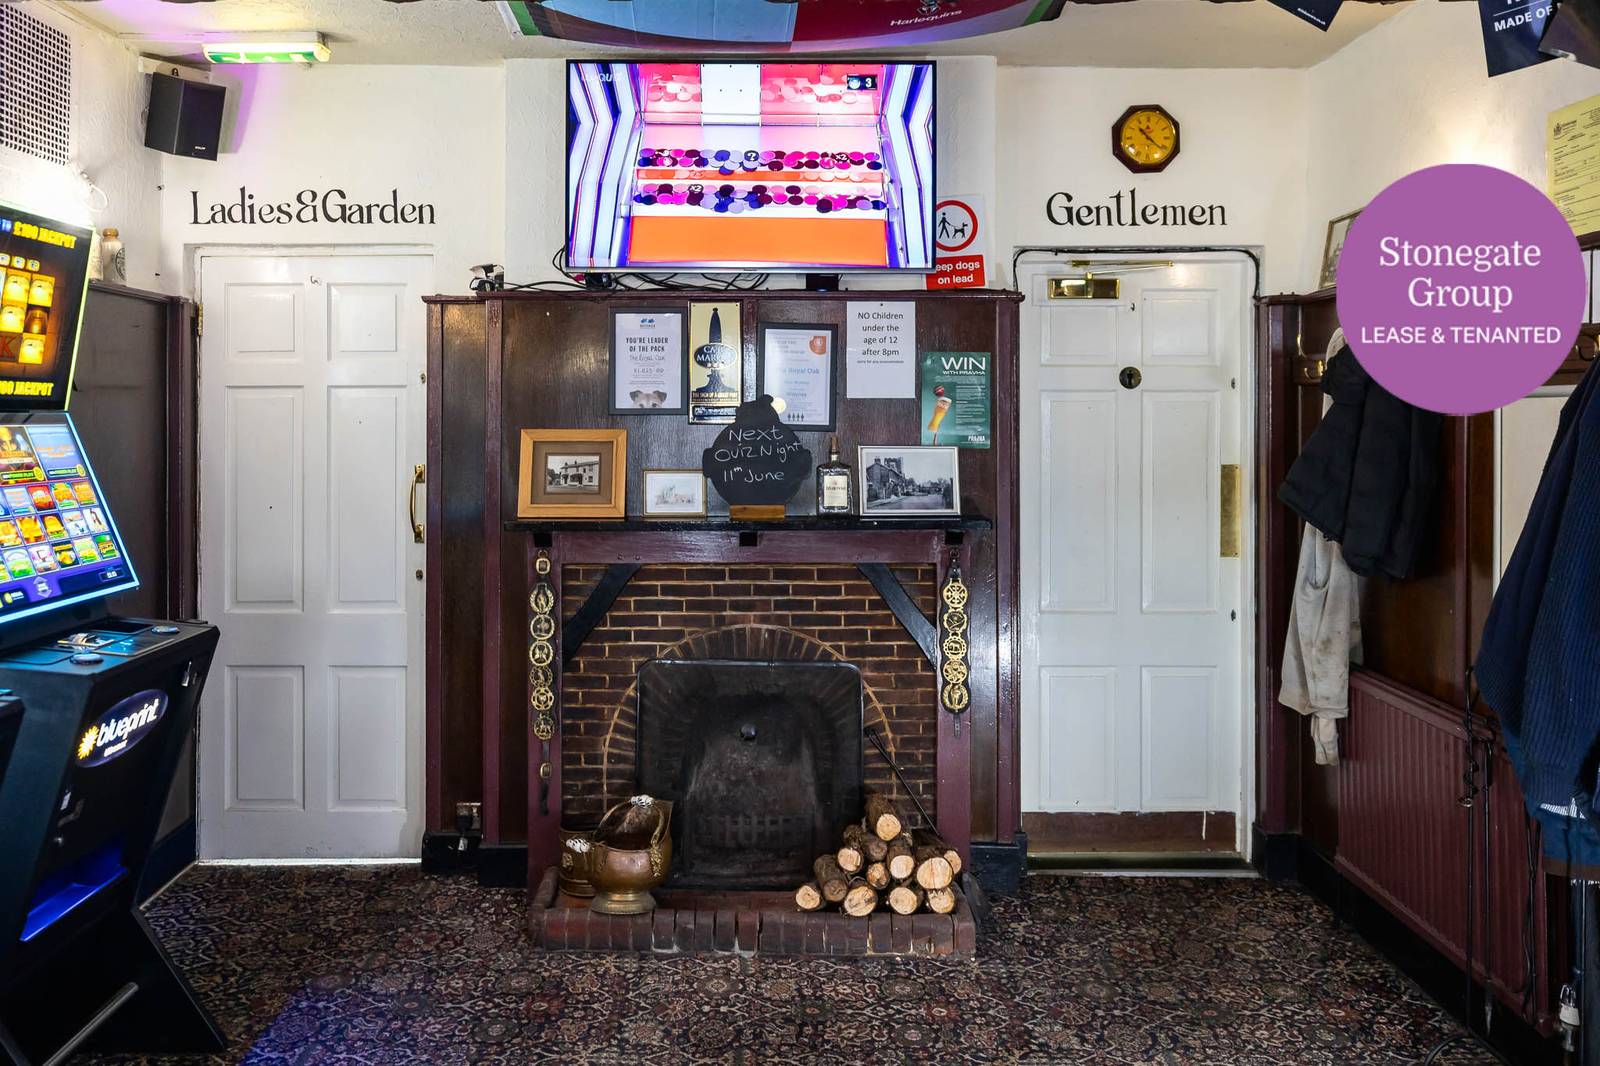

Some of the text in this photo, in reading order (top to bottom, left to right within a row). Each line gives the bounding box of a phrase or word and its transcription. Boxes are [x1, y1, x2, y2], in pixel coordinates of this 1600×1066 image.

[890, 10, 962, 26] Harlequins
[1494, 5, 1553, 31] MADE OF
[865, 78, 872, 88] 3
[1046, 187, 1227, 226] Gentlemen
[936, 261, 980, 272] eep dogs
[937, 274, 973, 284] on lead
[872, 312, 904, 320] Children
[882, 348, 900, 356] 8pm
[941, 357, 986, 370] WIN
[729, 425, 784, 441] Next
[760, 441, 801, 463] Night
[744, 469, 785, 483] June
[96, 698, 159, 747] blueprint
